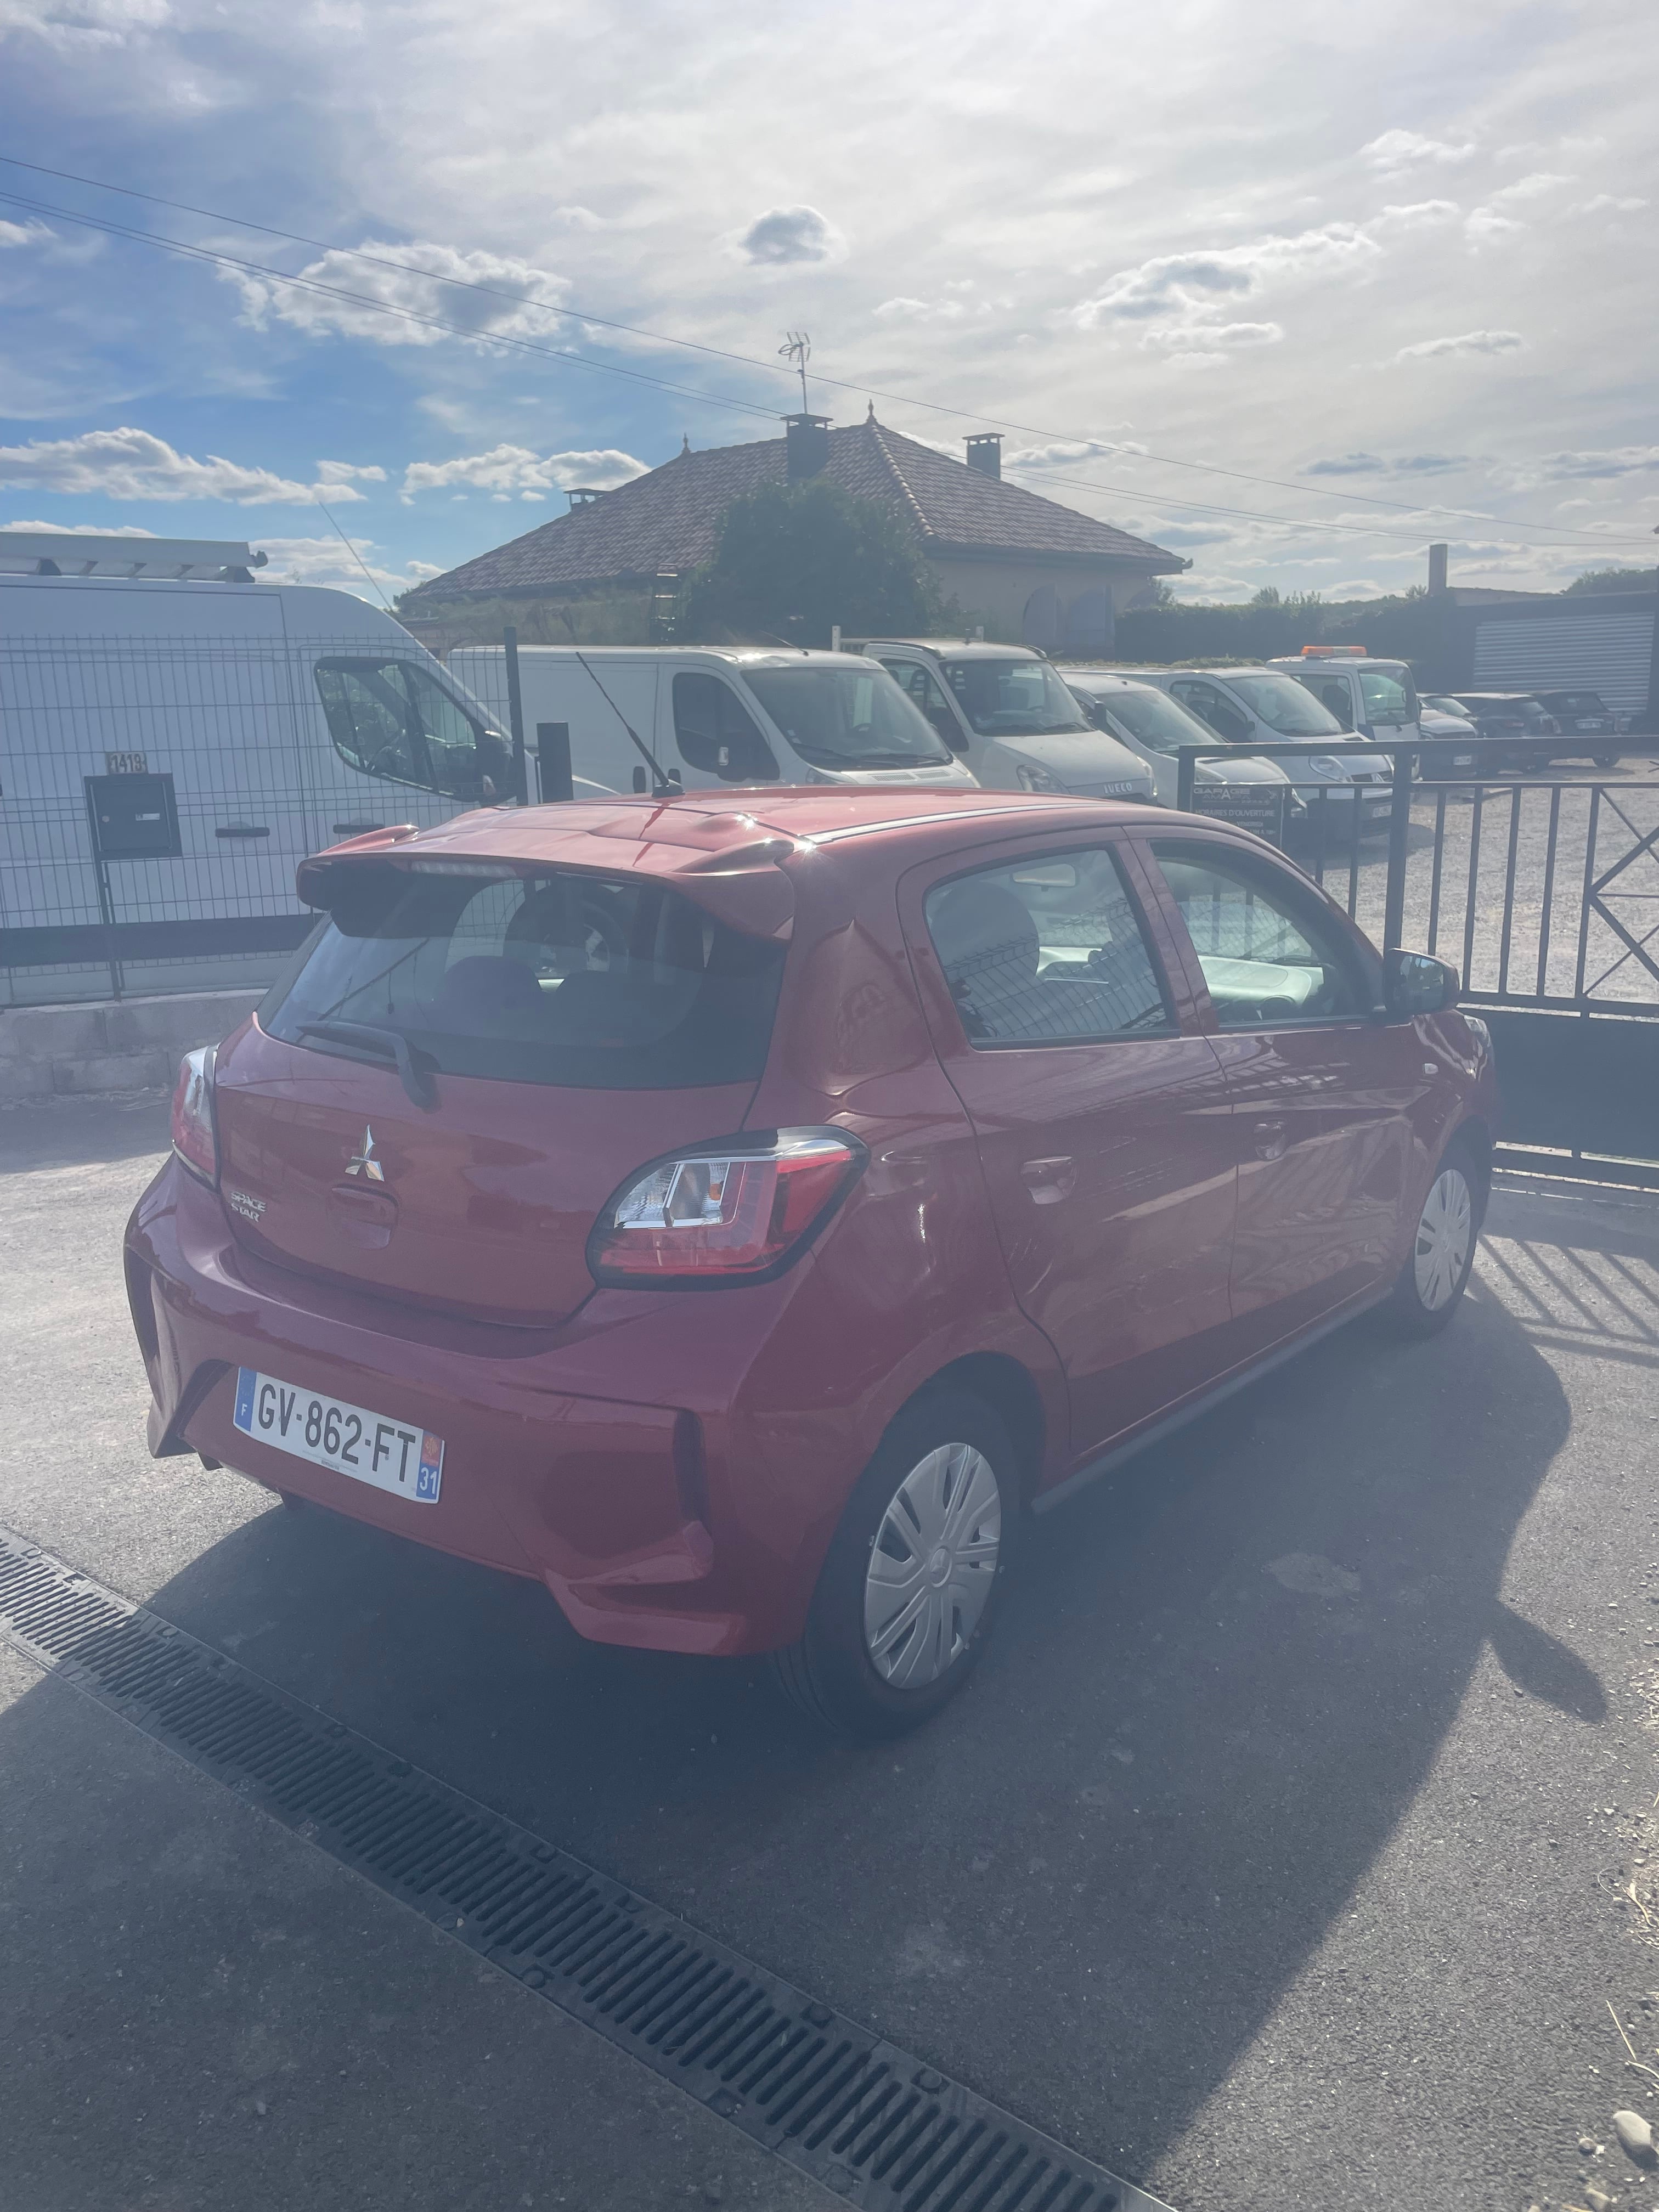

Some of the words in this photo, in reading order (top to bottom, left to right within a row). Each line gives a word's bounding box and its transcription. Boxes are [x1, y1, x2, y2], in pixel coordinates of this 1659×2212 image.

[1103, 783, 1132, 794] IVECO
[230, 1191, 267, 1212] SPACE
[231, 1203, 260, 1222] STAR
[241, 1403, 248, 1416] F
[258, 1384, 416, 1482] GV-862-FT
[419, 1467, 437, 1495] 31
